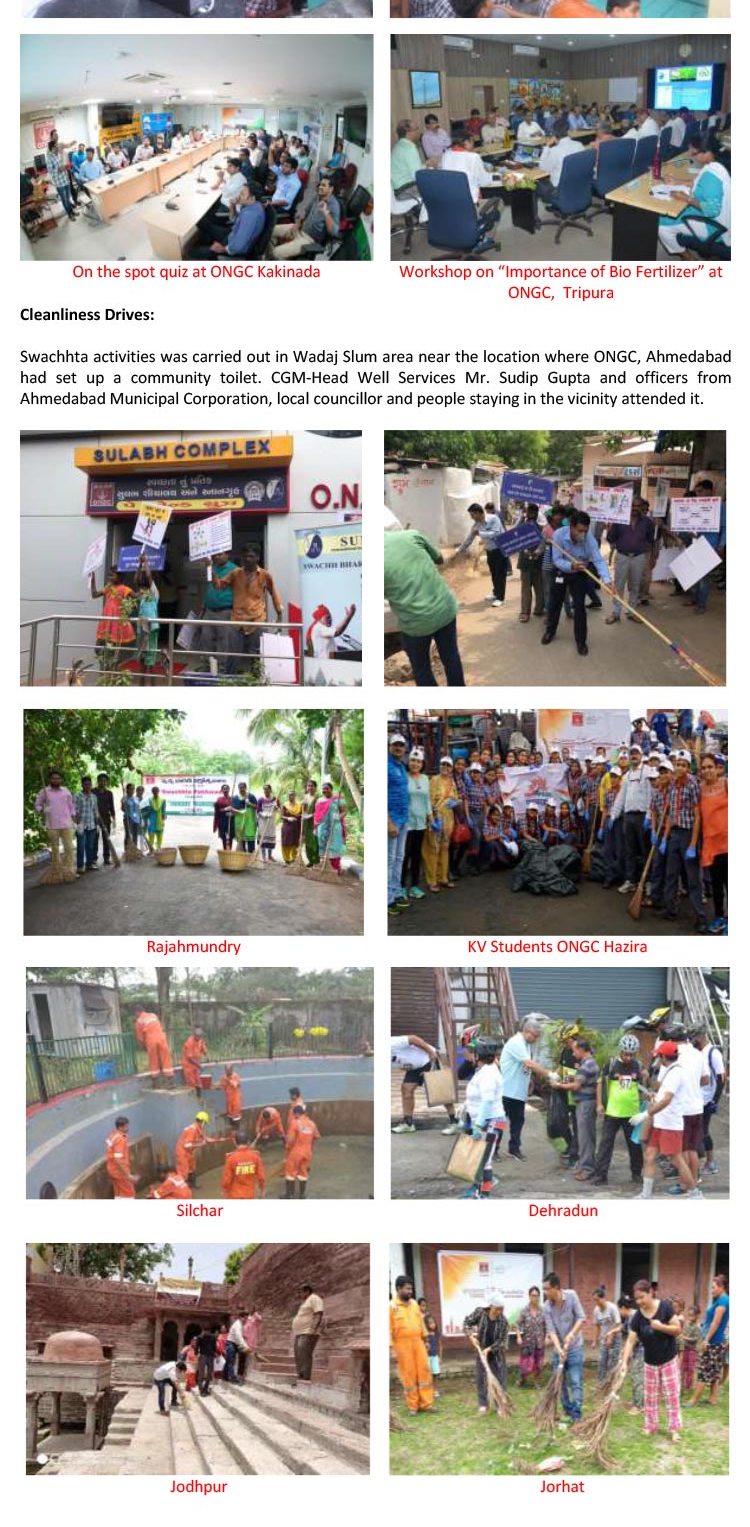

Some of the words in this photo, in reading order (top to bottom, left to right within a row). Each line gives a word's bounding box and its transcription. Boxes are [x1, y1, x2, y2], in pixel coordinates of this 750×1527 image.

[73, 265, 92, 278] On
[97, 265, 120, 278] the
[125, 266, 155, 280] spot
[160, 265, 188, 280] quiz
[193, 266, 206, 278] at
[211, 265, 253, 278] ONGC
[258, 265, 320, 278] Kakinada
[20, 308, 100, 321] Cleanliness
[105, 308, 154, 320] Drives:
[94, 447, 169, 463] SULABH
[174, 440, 271, 458] COMPLEX
[340, 536, 362, 547] SU
[148, 940, 241, 955] Rajahmundry
[469, 941, 487, 952] KV
[491, 940, 552, 953] Students
[557, 940, 599, 953] ONGC
[605, 940, 647, 952] Hazira
[235, 1164, 256, 1175] FIRE
[177, 1204, 224, 1216] Silchar
[529, 1204, 598, 1217] Dehradun
[170, 1480, 228, 1495] Jodhpur
[540, 1480, 584, 1493] Jorhat
